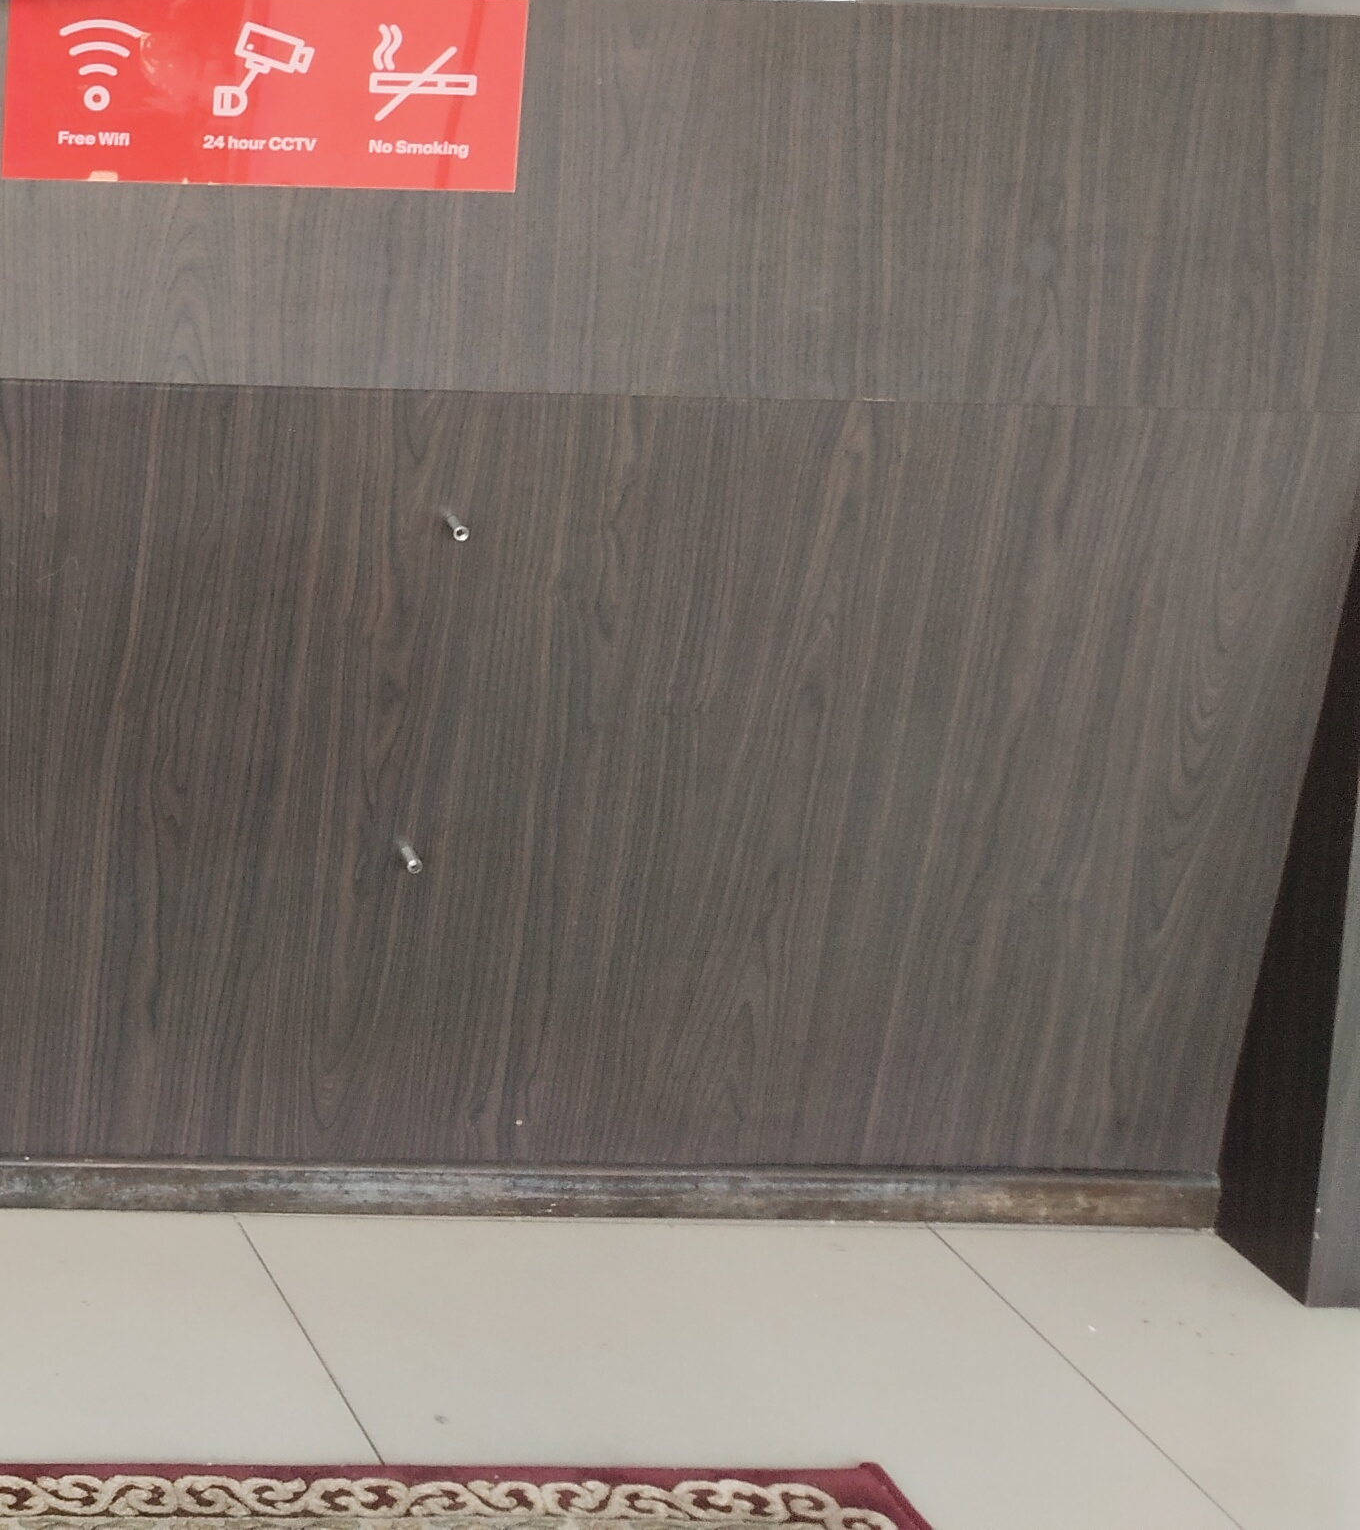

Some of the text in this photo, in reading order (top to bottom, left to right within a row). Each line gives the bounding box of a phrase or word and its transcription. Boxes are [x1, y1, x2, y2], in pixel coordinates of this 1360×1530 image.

[58, 130, 130, 147] Free Wifi
[202, 135, 318, 153] 24 hour CCTV
[368, 139, 470, 159] No Smoking
